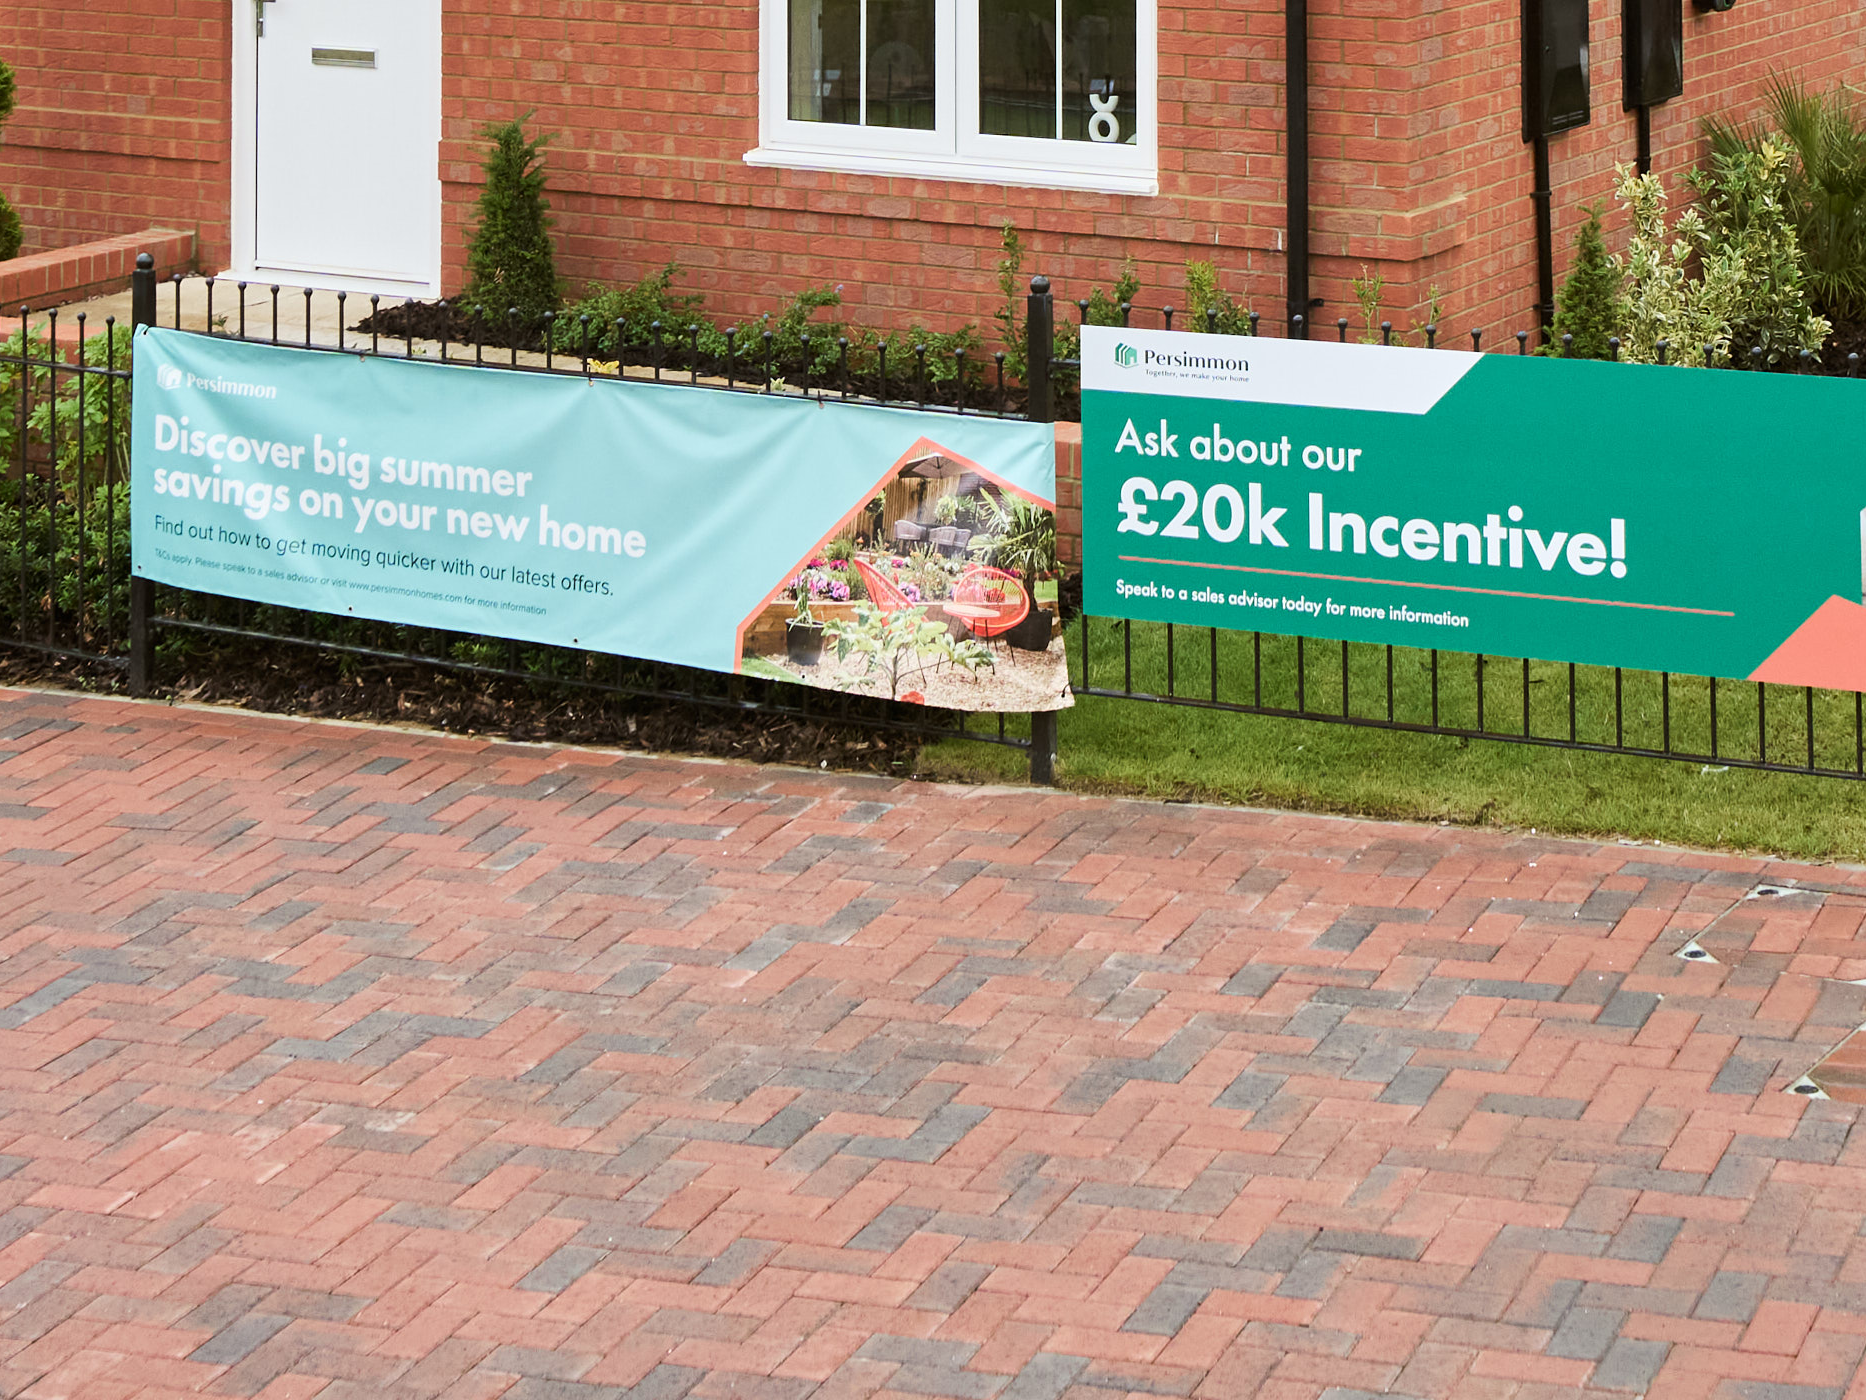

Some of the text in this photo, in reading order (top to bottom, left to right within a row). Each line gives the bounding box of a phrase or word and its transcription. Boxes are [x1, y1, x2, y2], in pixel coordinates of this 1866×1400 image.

[187, 371, 277, 399] Persimmon
[1144, 349, 1249, 372] Persimmon
[1145, 368, 1178, 379] Together,
[1191, 372, 1210, 380] make
[1211, 375, 1227, 383] your
[1229, 374, 1250, 383] home
[154, 413, 533, 497] Discover big summer
[1114, 417, 1363, 472] Ask about our
[154, 463, 647, 558] savings on your new home
[1117, 476, 1628, 579] £20k Incentive!
[155, 514, 614, 597] Find out how to get moving quicker with our latest offers.
[171, 554, 192, 567] apply.
[195, 557, 221, 570] Please
[222, 561, 246, 575] speak
[246, 565, 256, 575] to
[257, 568, 263, 576] a
[264, 568, 284, 579] sales
[286, 571, 318, 585] advisor
[320, 576, 330, 585] or
[331, 577, 348, 588] visit
[349, 580, 463, 604] www.persimmonhomes.com
[464, 595, 476, 606] for
[477, 598, 498, 609] more
[500, 600, 547, 616] information
[1115, 578, 1469, 628] Speak to a sales advisor today for more information
